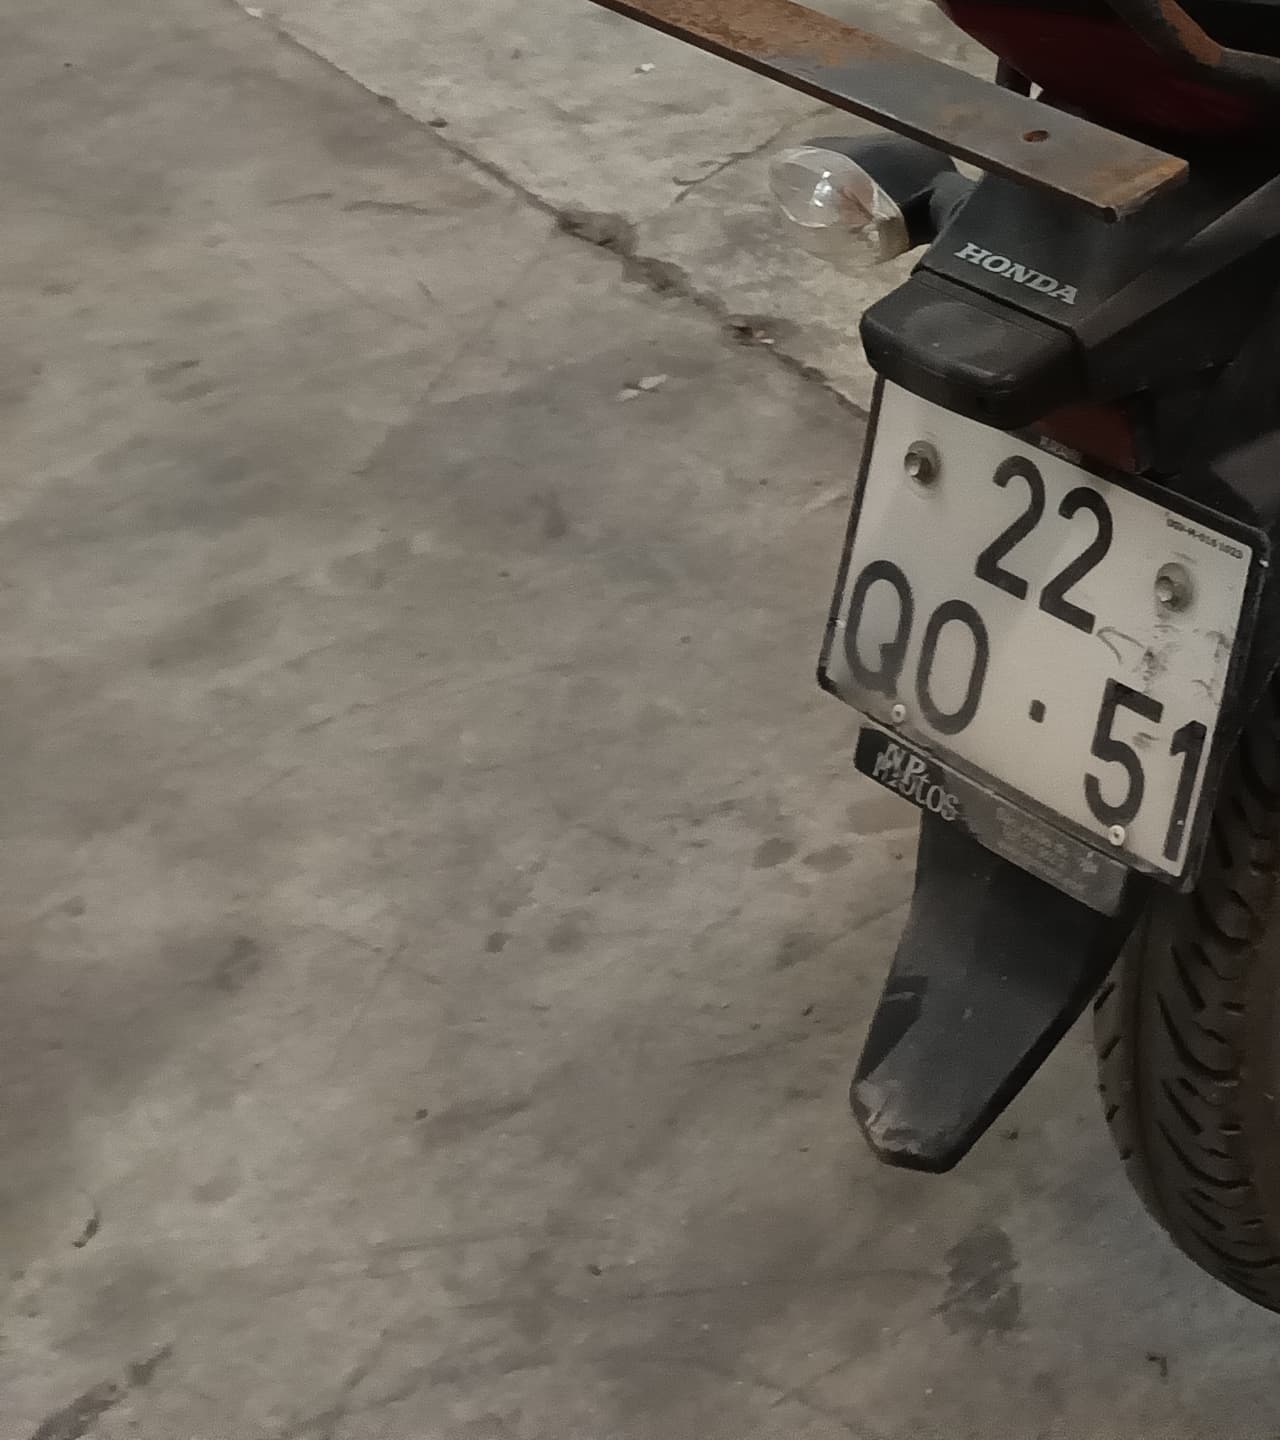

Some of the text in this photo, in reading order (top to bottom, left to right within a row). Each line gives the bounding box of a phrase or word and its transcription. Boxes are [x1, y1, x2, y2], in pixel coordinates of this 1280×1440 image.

[953, 242, 1078, 304] HONDA
[975, 455, 1113, 635] 22
[1084, 678, 1208, 862] 51
